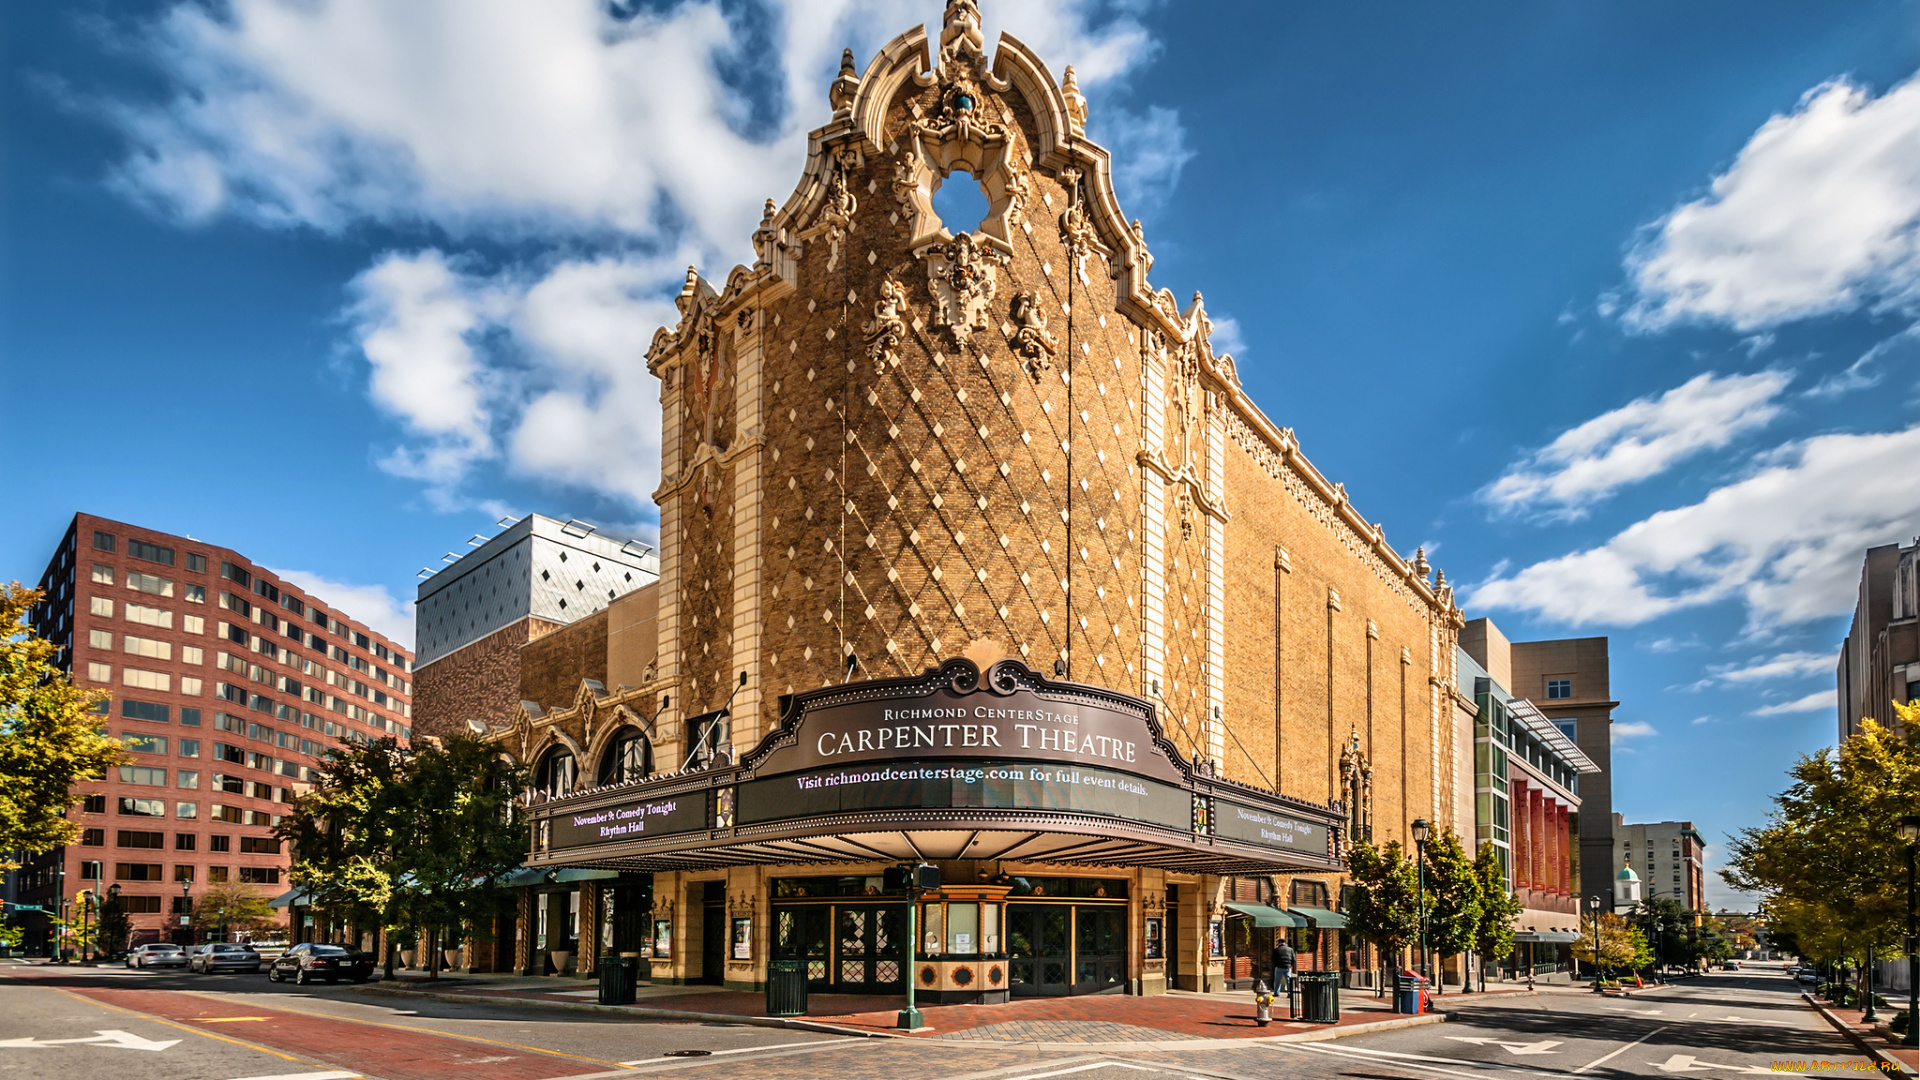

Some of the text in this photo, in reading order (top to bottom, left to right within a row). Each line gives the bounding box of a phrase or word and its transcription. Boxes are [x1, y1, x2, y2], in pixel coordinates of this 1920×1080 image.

[884, 706, 1079, 725] RICHMOND CENTERSTAGE
[817, 723, 1136, 763] CARPENTER THEATRE
[797, 767, 1149, 796] Visit richmondcenterstage.com for full event details.
[573, 813, 608, 827] November
[616, 806, 645, 820] Comedy
[646, 801, 677, 816] Tonight
[1237, 808, 1266, 824] November
[1272, 817, 1293, 832] Comedy
[1294, 821, 1312, 835] Tonight
[600, 821, 645, 838] Rhythm Hall
[1261, 828, 1293, 843] Rhythm Hall
